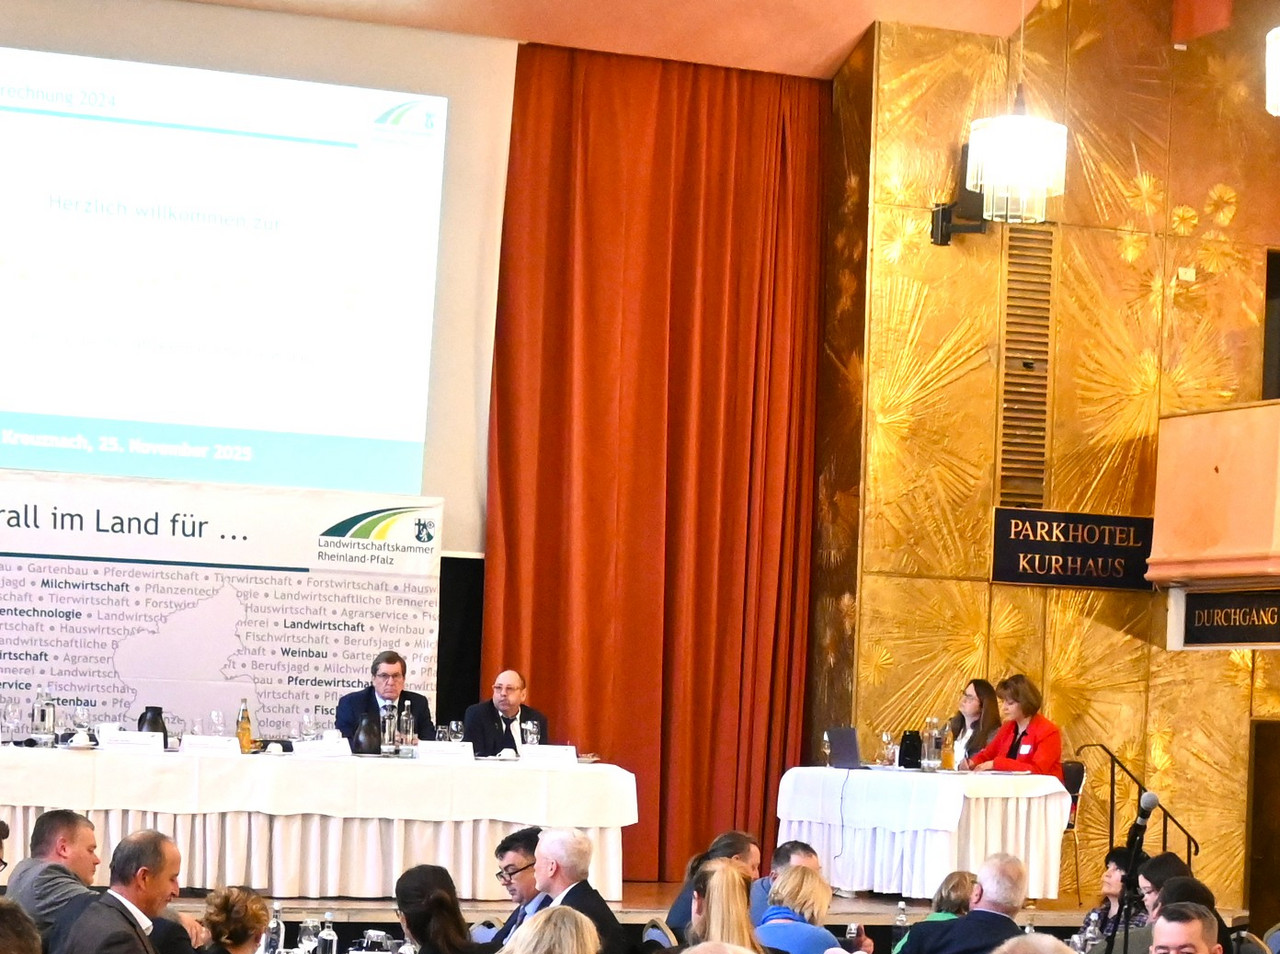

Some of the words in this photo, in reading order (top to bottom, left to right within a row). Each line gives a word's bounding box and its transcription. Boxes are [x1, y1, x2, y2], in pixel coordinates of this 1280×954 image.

[129, 437, 209, 460] November
[214, 444, 253, 463] 2025
[51, 505, 83, 531] im
[96, 508, 159, 536] Land
[169, 513, 209, 538] für
[1009, 519, 1142, 547] PARKHOTEL
[317, 538, 434, 555] Landwirtschaftskammer
[317, 551, 395, 566] Rheinland-Pfalz
[1018, 553, 1125, 578] KURHAUS
[27, 563, 89, 576] Gartenbau
[103, 567, 200, 581] Pferdewirtschaft
[306, 577, 389, 592] Forstwirtschaft
[40, 578, 130, 593] Milchwirtschaft
[273, 590, 382, 605] Landwirtschaftliche
[385, 595, 437, 607] Brennerei
[48, 593, 130, 607] Tierwirtschaft
[245, 603, 327, 616] Hauswirtschaft
[340, 608, 409, 621] Agrarservice
[1194, 607, 1278, 627] DURCHGANG
[283, 618, 365, 632] Landwirtschaft
[379, 623, 425, 635] Weinbau
[245, 631, 329, 645] Fischwirtschaft
[343, 636, 401, 649] Berufsjagd
[280, 647, 328, 658] Weinbau
[251, 660, 310, 674] Berufsjagd
